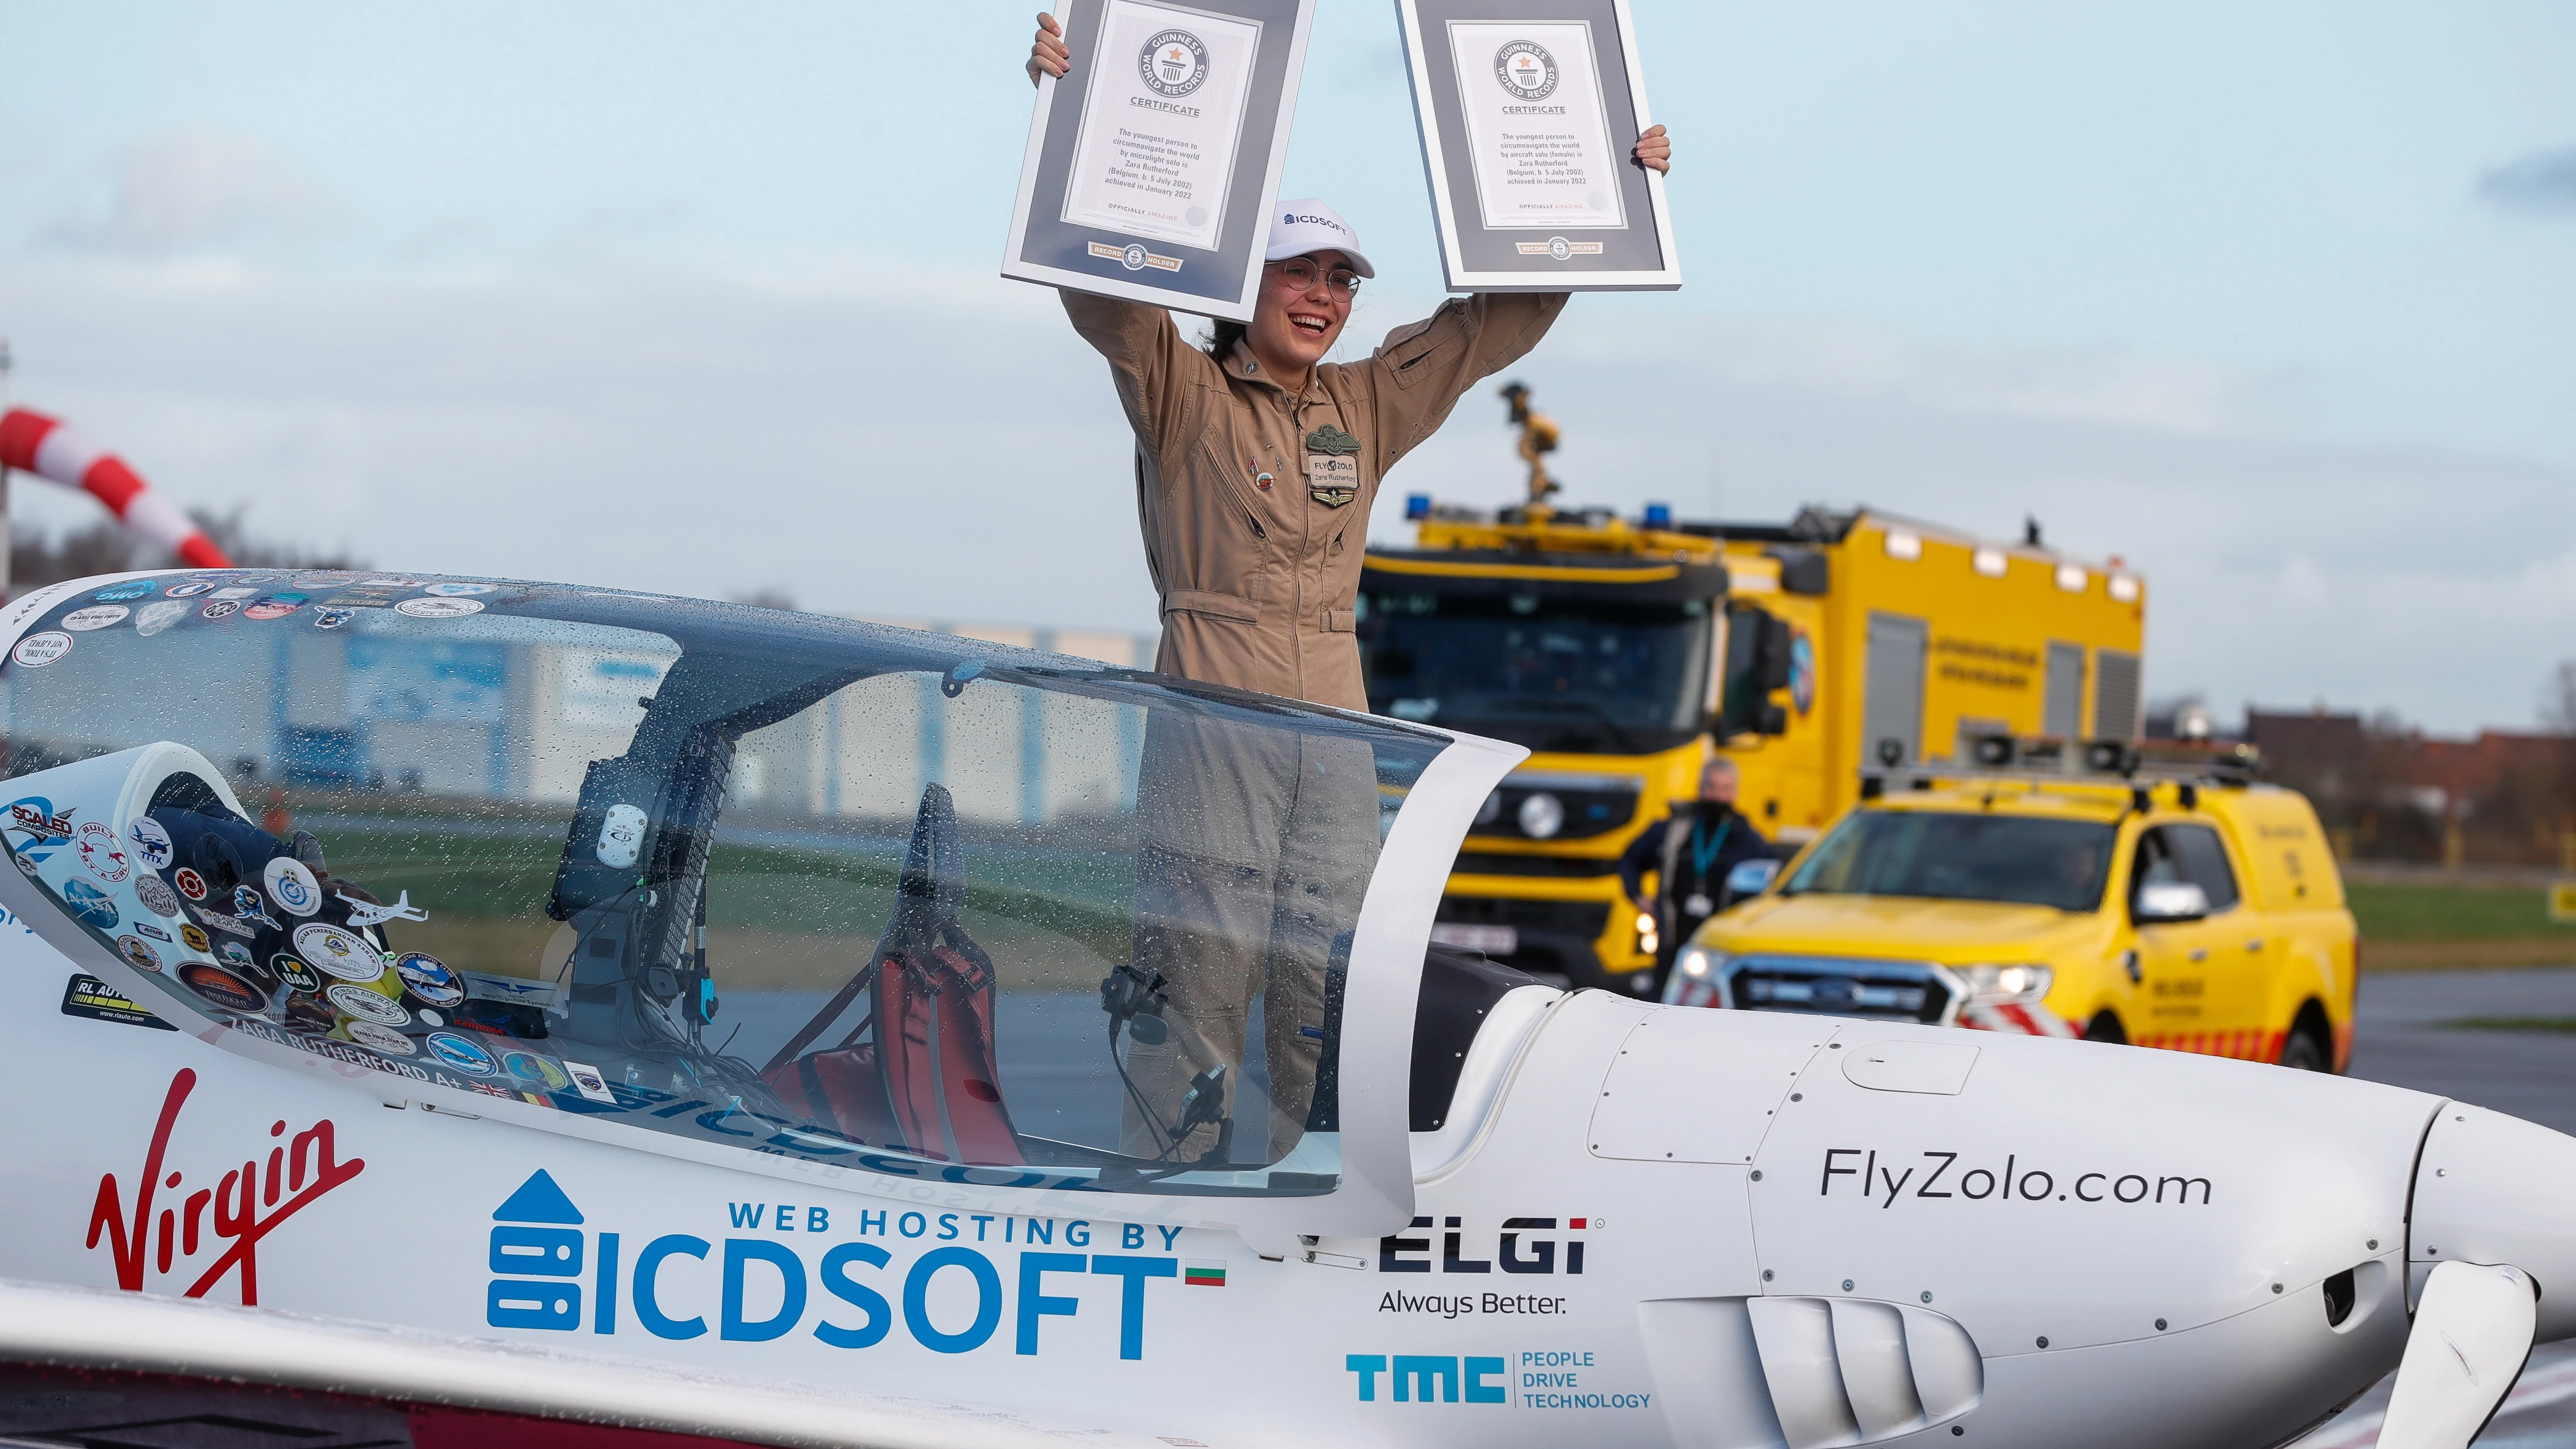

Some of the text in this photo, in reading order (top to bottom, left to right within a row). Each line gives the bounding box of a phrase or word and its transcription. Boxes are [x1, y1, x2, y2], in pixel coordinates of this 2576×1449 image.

[1152, 33, 1203, 55] GUINNESS
[1501, 43, 1547, 60] GUINNESS
[1143, 54, 1205, 94] WORLD RECORDS
[1498, 66, 1555, 98] WORLD RECORDS
[1130, 96, 1201, 116] CERTIFICATE
[1119, 128, 1131, 136] The
[1133, 132, 1164, 143] youngest
[1166, 138, 1189, 148] person
[1113, 138, 1165, 153] circumnavigate
[1180, 151, 1200, 160] world
[1120, 149, 1129, 157] by
[1130, 152, 1165, 163] microlight
[1125, 160, 1179, 176] Zara Rutherford
[1105, 177, 1136, 188] achieved
[1145, 185, 1173, 197] January
[1175, 190, 1192, 199] 2022
[1108, 167, 1140, 179] (Belgium,
[1157, 177, 1171, 186] July
[1173, 179, 1192, 190] 2002)
[1108, 203, 1179, 221] OFFICIALLY AMAZING
[1295, 215, 1346, 236] ICDSOFT
[1094, 246, 1175, 267] RECORD HOLDER
[1337, 462, 1353, 471] ZOLO
[11, 805, 72, 835] SCALED
[17, 820, 70, 840] COMPOSITES
[82, 825, 116, 839] BUILT
[82, 855, 96, 869] BY
[68, 892, 116, 915] NASA
[212, 913, 242, 925] ALASKA
[213, 918, 253, 934] SEAPLANES
[143, 927, 164, 936] ASUR
[300, 929, 376, 964] KELAB PENERBANGAN SABAH
[281, 961, 290, 972] I
[399, 954, 417, 966] SELETAR
[418, 954, 438, 965] FLYING
[282, 972, 315, 986] UAA
[78, 982, 130, 999] RL AUT
[333, 988, 401, 1013] WINGS AIRWAYS
[99, 1010, 144, 1022] www.rlauto.com
[296, 1015, 316, 1024] BOEING
[358, 1011, 385, 1021] GLACIER
[455, 1018, 504, 1035] KARISMA
[226, 1015, 286, 1045] ZARA
[288, 1033, 429, 1081] RUTHERFORD
[435, 1071, 462, 1089] A+
[86, 1067, 365, 1307] Virgin
[1820, 1148, 2212, 1209] FlyZolo.com
[728, 1201, 1184, 1252] WEB HOSTING BY
[594, 1231, 1178, 1362] ICDSOFT
[1378, 1290, 1567, 1319] Always Better.
[1522, 1352, 1595, 1367] PEOPLE
[1346, 1354, 1506, 1404] TMC
[1523, 1373, 1578, 1388] DRIVE
[1523, 1394, 1651, 1409] TECHNOLOGY
